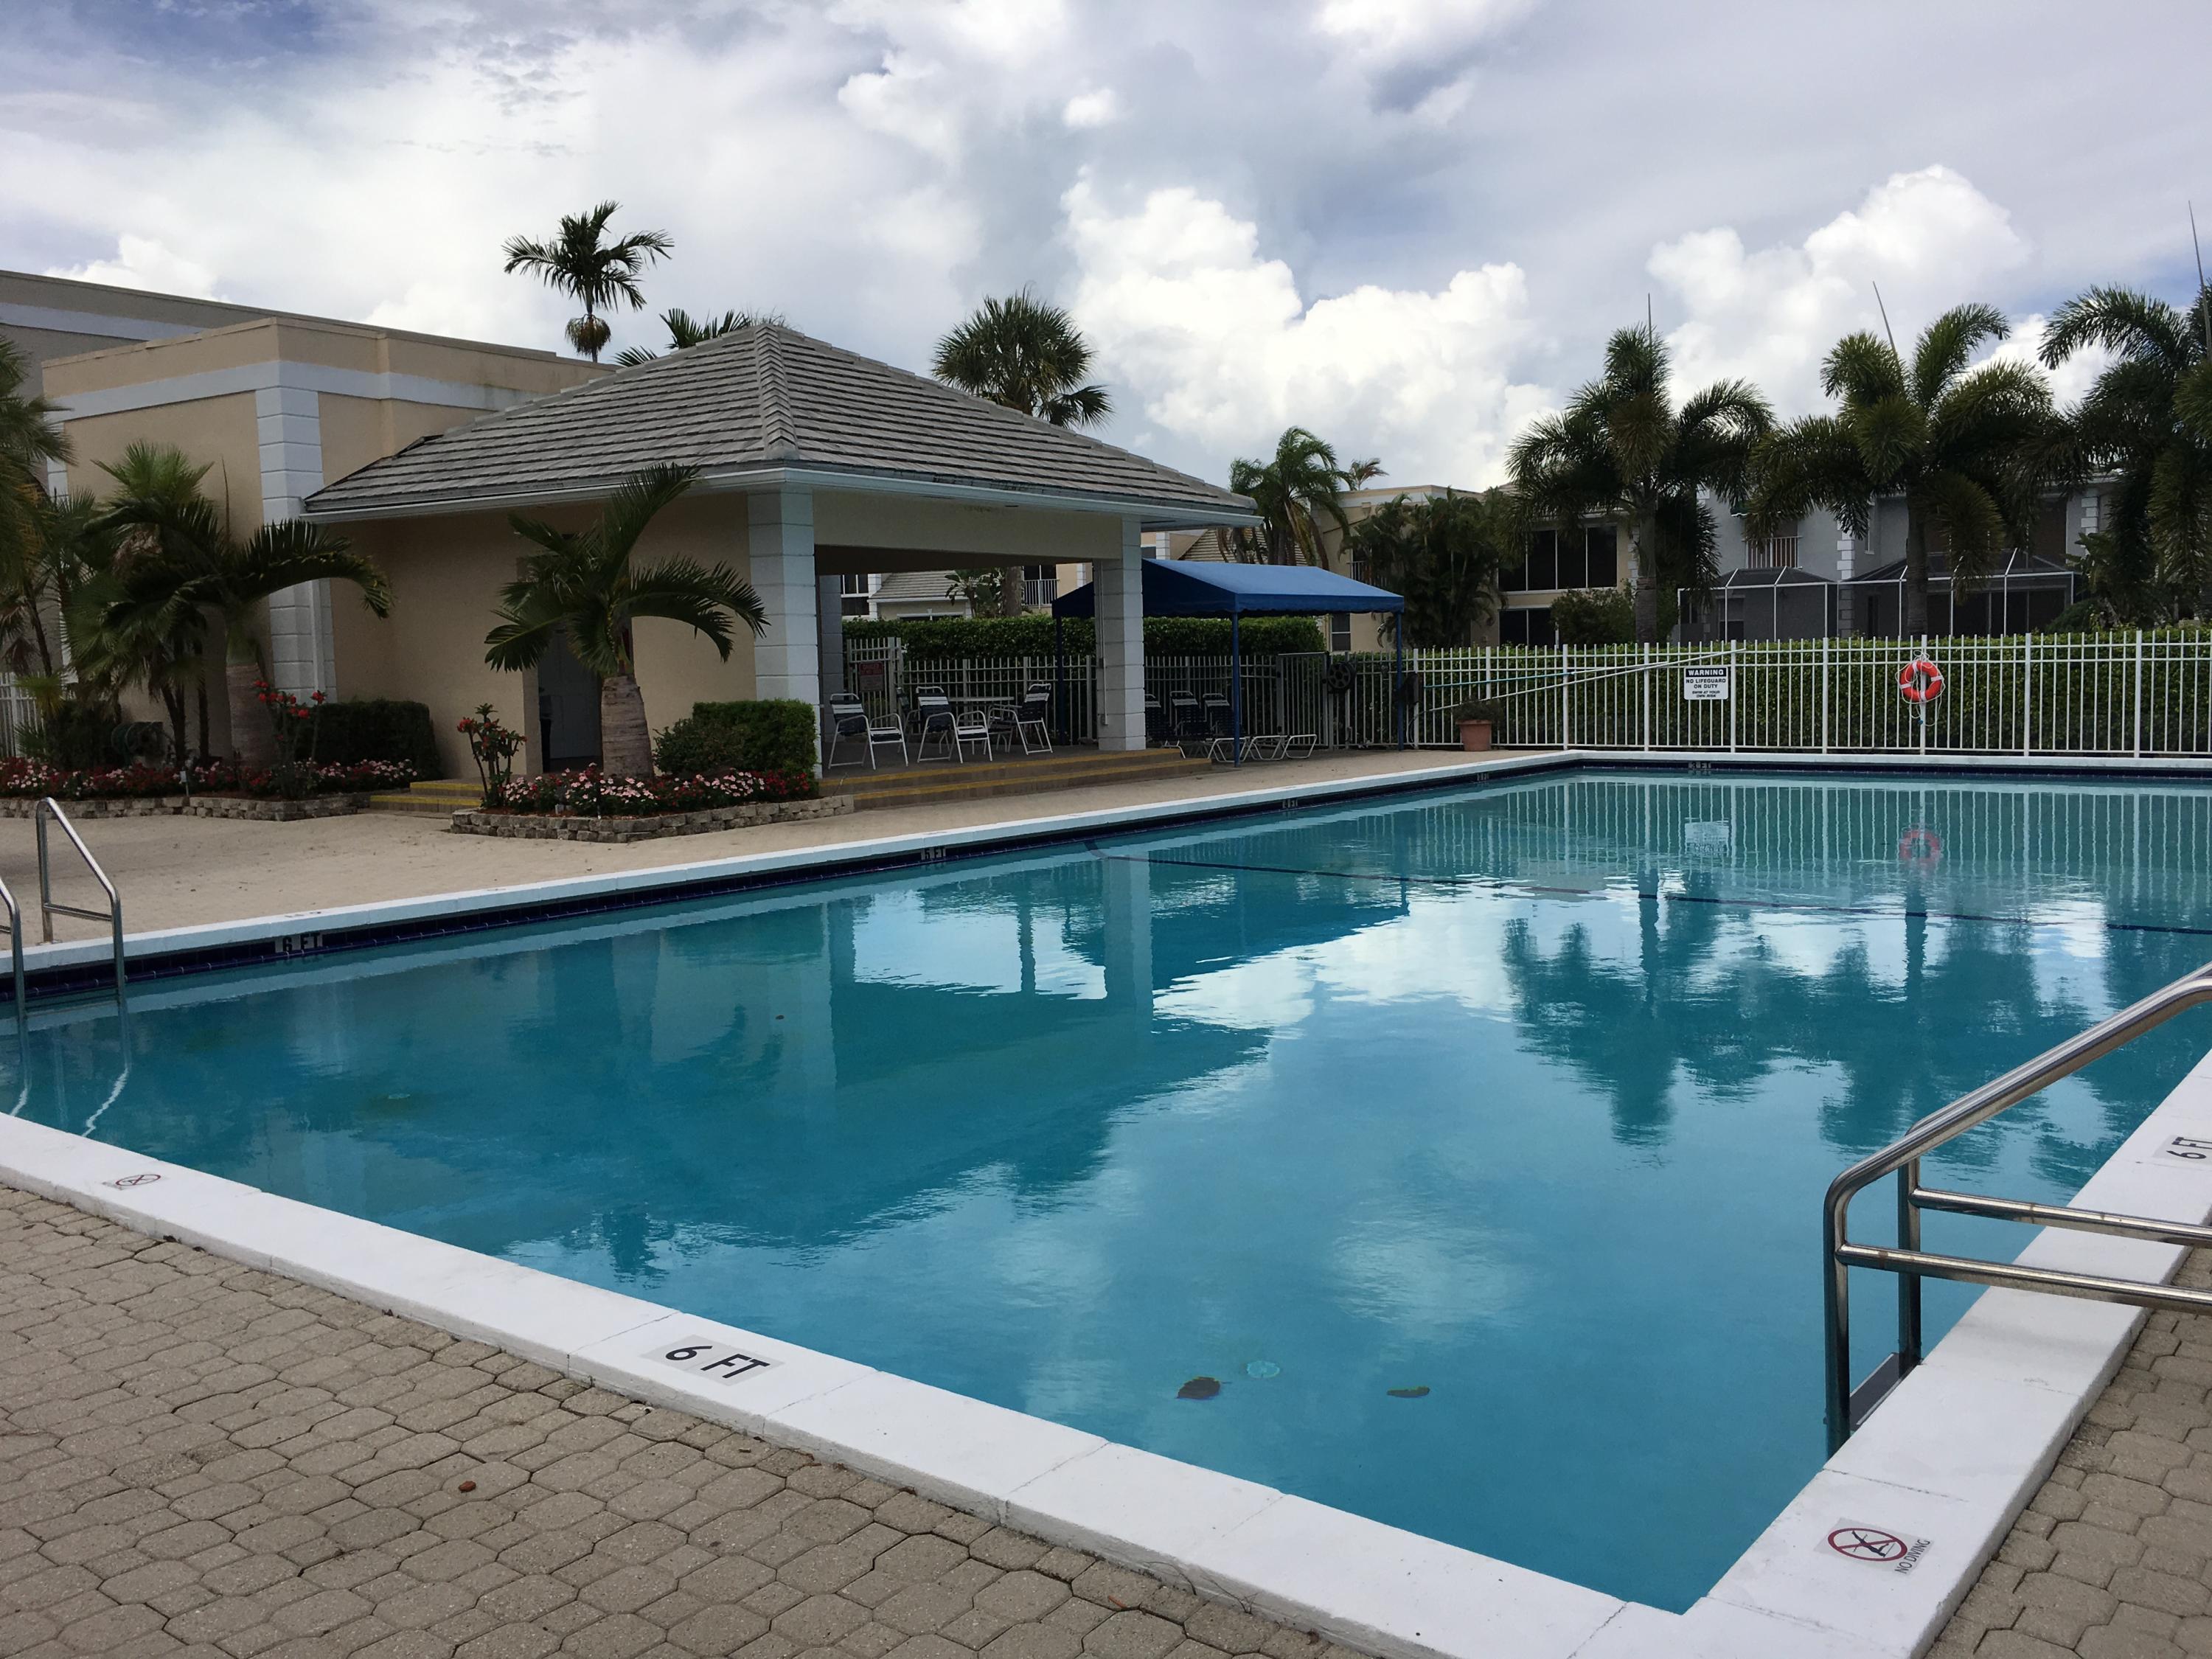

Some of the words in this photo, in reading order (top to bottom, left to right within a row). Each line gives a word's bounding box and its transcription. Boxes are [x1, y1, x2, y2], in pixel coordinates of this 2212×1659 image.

[282, 936, 293, 952] 6
[300, 933, 320, 950] FT
[2171, 1136, 2212, 1150] FT
[2166, 1150, 2207, 1159] 6
[665, 1345, 713, 1361] 6
[700, 1353, 771, 1379] FT
[1903, 1539, 1931, 1562] DIVING
[1894, 1561, 1913, 1574] NO
